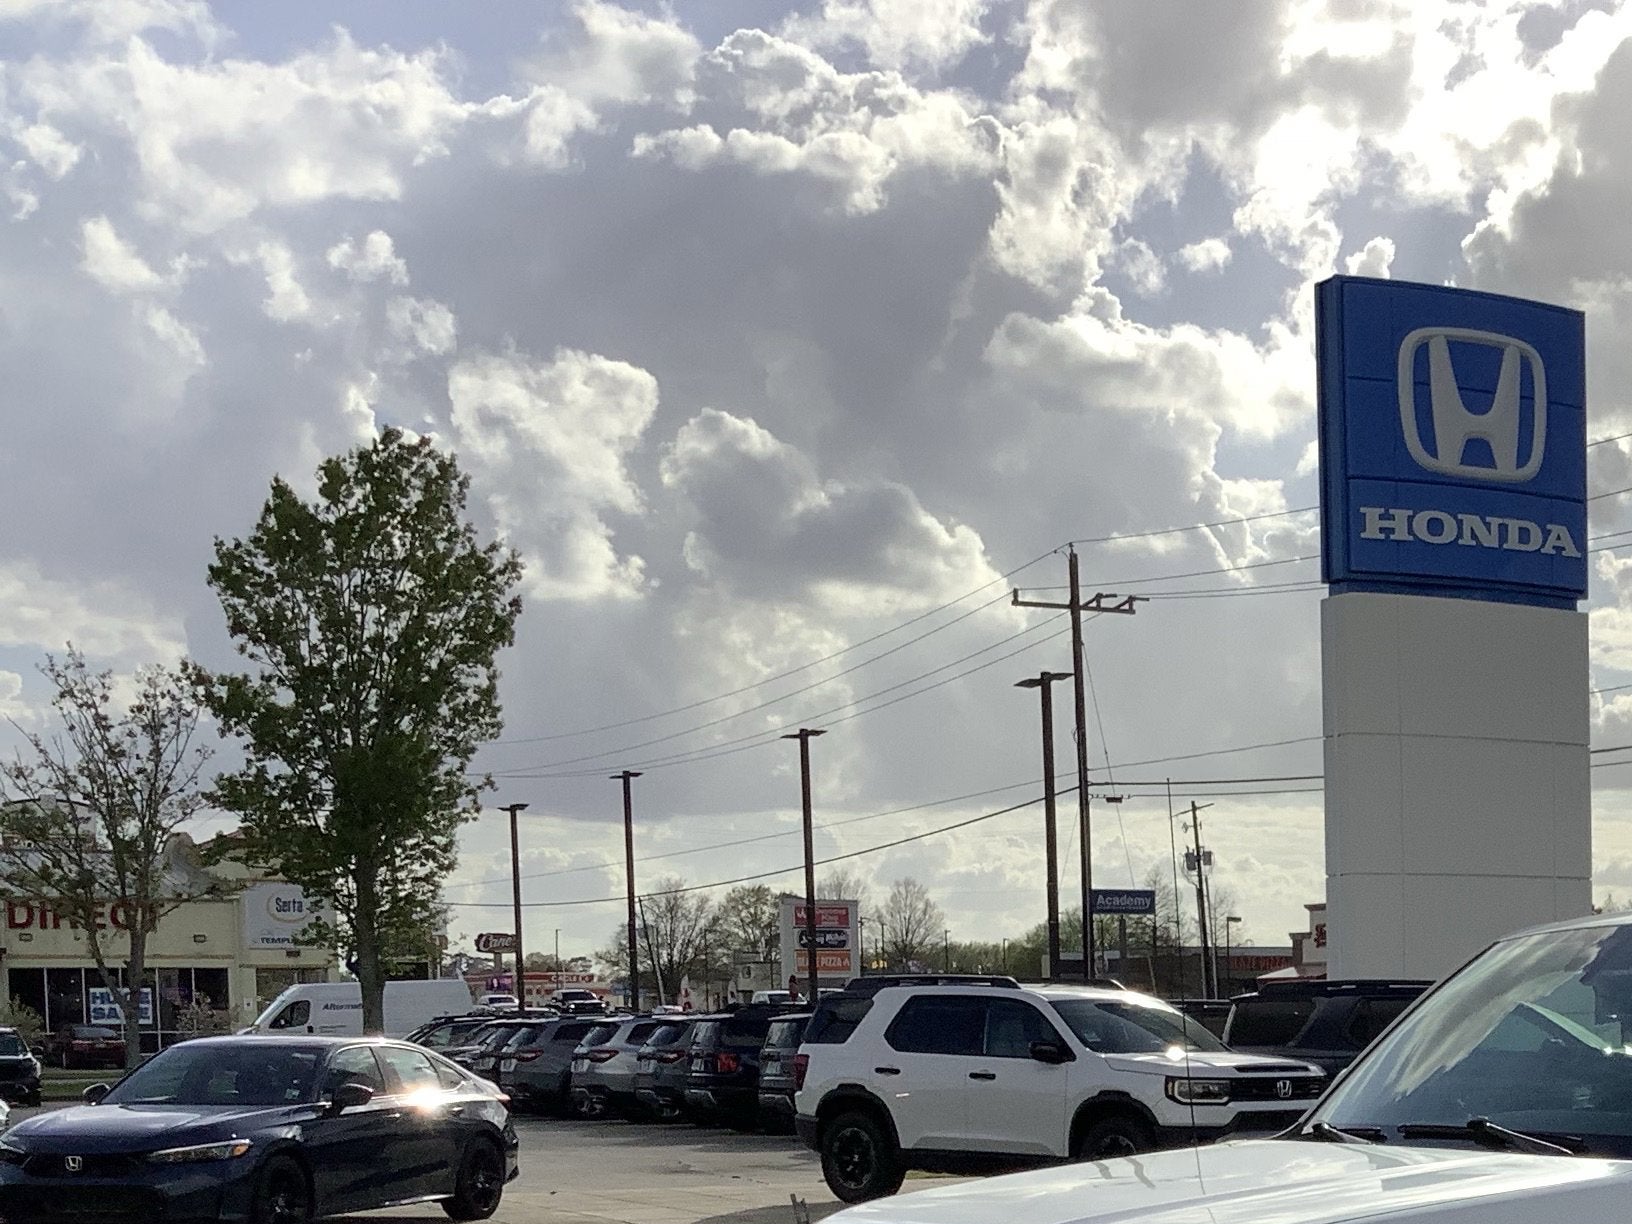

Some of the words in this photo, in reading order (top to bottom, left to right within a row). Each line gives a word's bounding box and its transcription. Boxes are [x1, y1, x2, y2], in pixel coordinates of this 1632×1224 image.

[1360, 506, 1582, 559] HONDA
[275, 897, 304, 913] Serta
[1096, 894, 1151, 909] Academy
[821, 956, 843, 968] PIZZA
